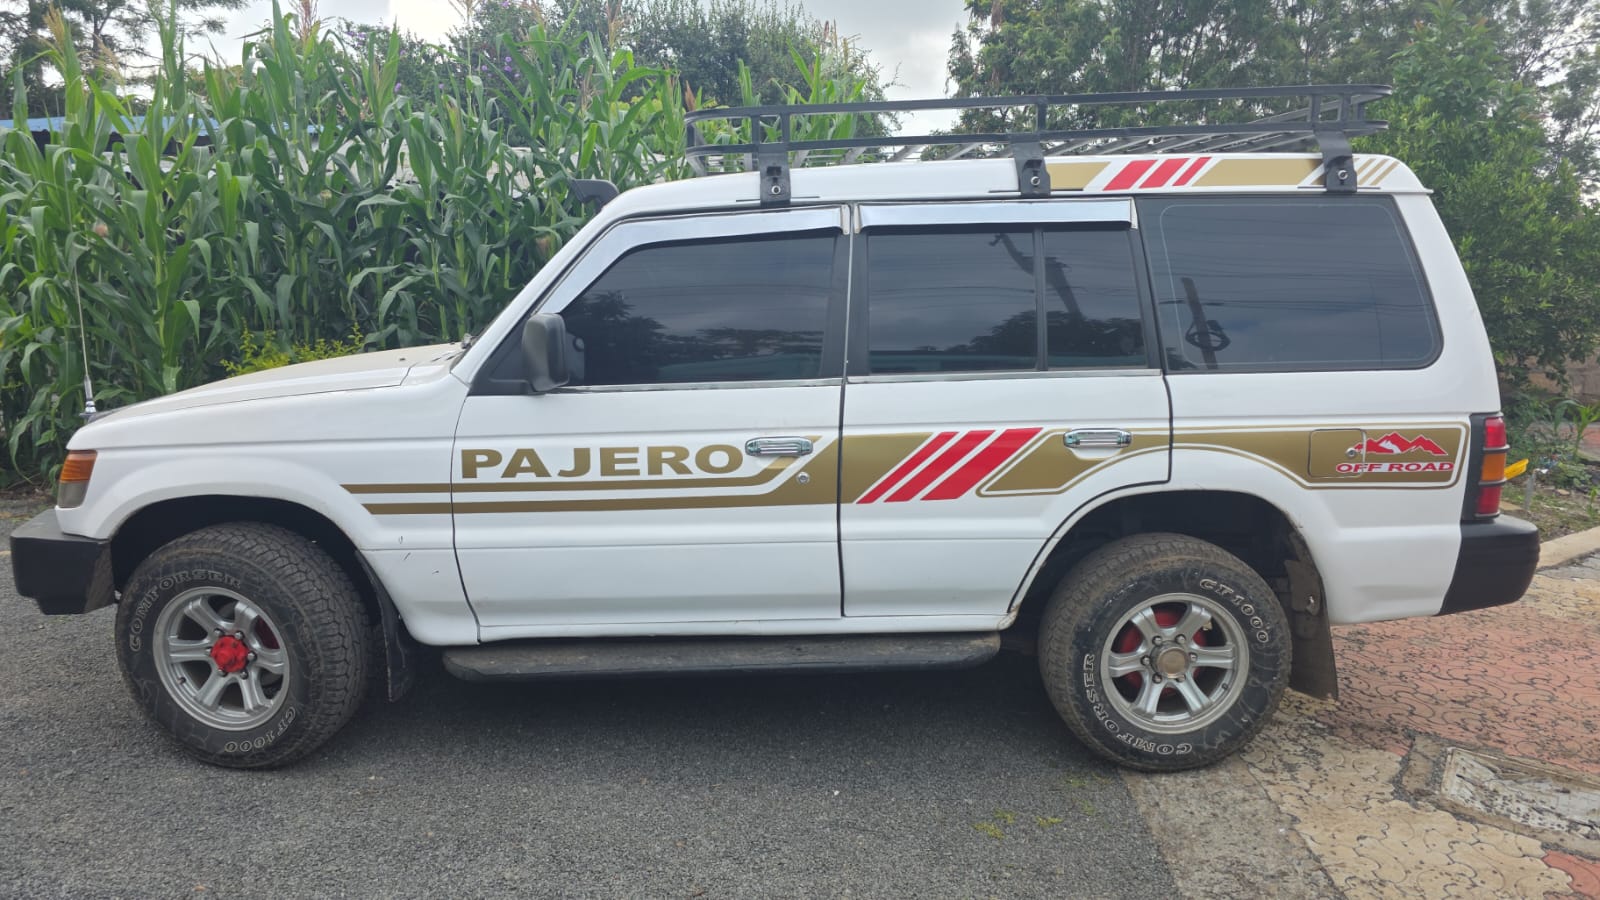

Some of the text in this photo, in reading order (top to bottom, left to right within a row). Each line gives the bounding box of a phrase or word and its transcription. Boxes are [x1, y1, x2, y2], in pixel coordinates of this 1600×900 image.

[460, 443, 744, 479] PAJERO
[1336, 461, 1454, 474] OFF ROAD
[129, 569, 241, 652] COMFORSER
[1199, 578, 1269, 643] CF1000
[1083, 653, 1193, 755] COMFORSER
